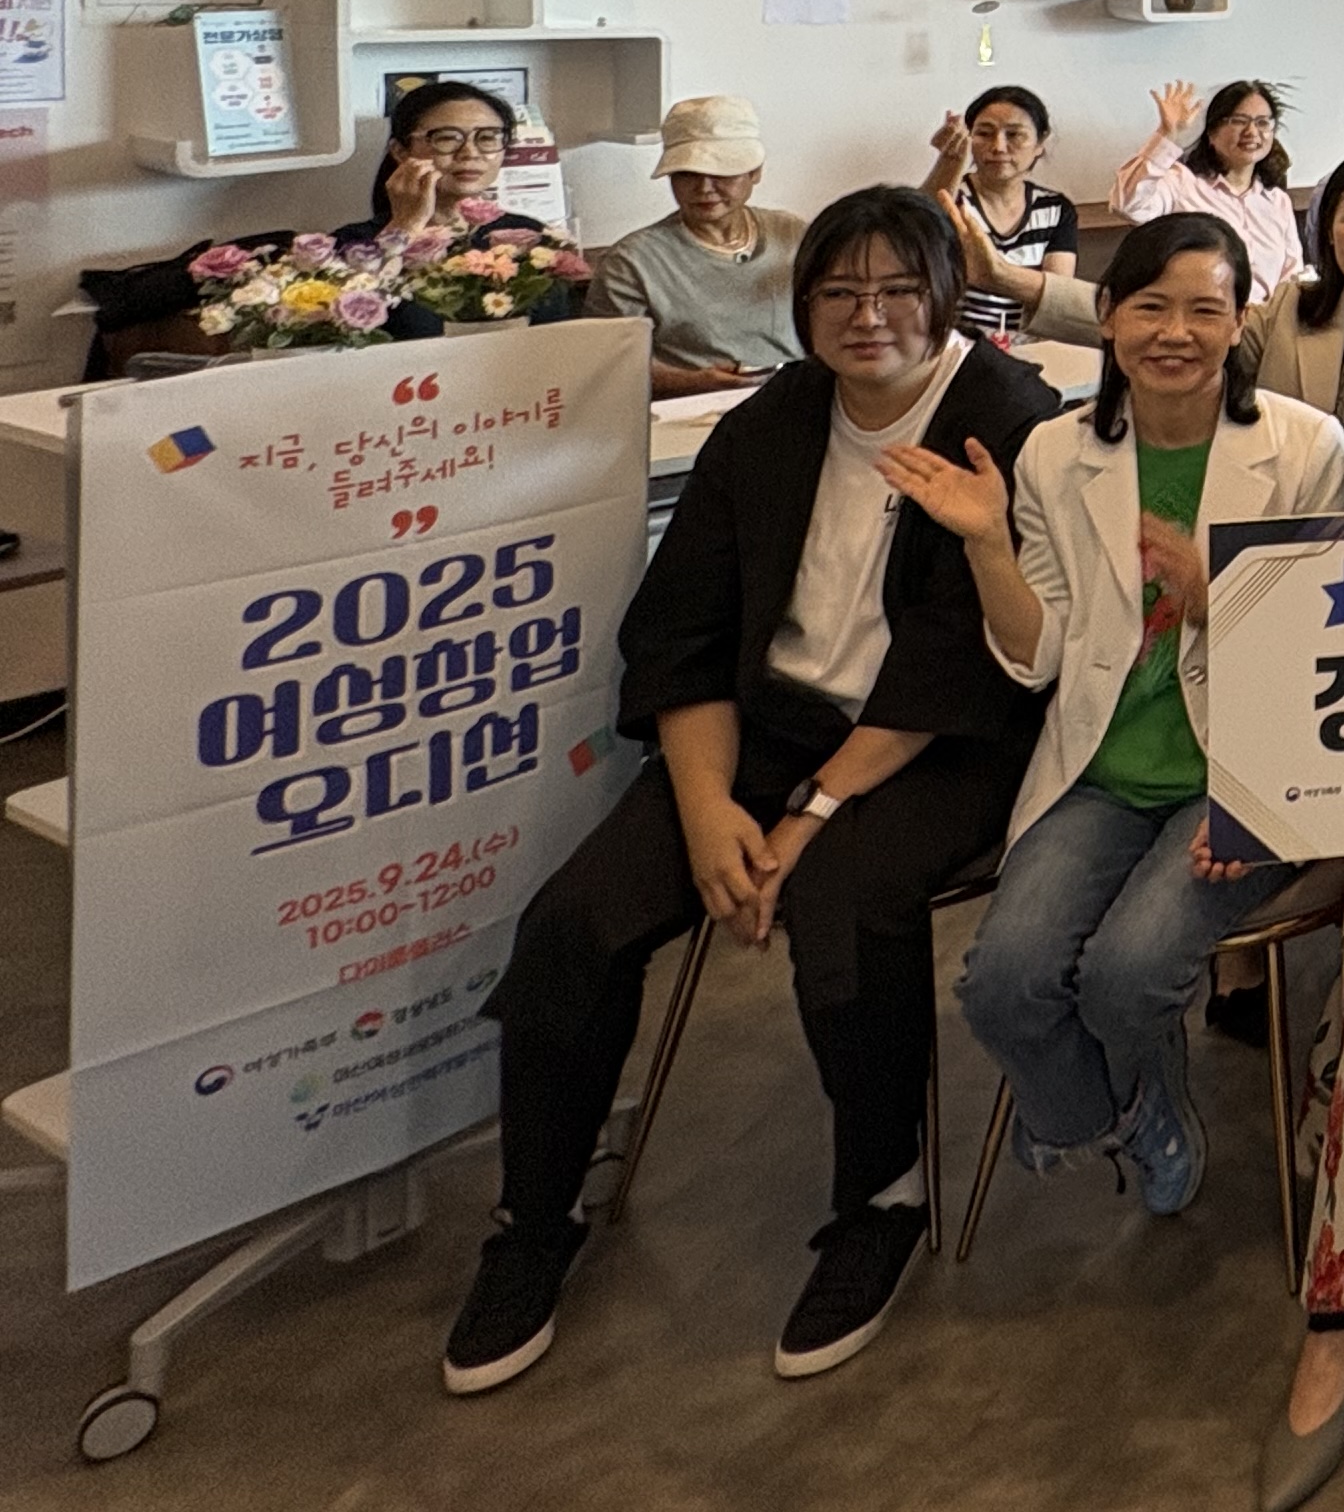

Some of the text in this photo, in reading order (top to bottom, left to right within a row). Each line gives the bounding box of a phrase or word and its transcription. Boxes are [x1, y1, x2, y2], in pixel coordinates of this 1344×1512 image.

[239, 387, 565, 472] 지금, 당신의 이야기를
[328, 444, 494, 510] 들려주세요!
[242, 533, 556, 670] 2025
[198, 605, 582, 767] 여성창업
[250, 701, 539, 857] 오디션
[277, 825, 520, 927] 2025.9.24.(수)
